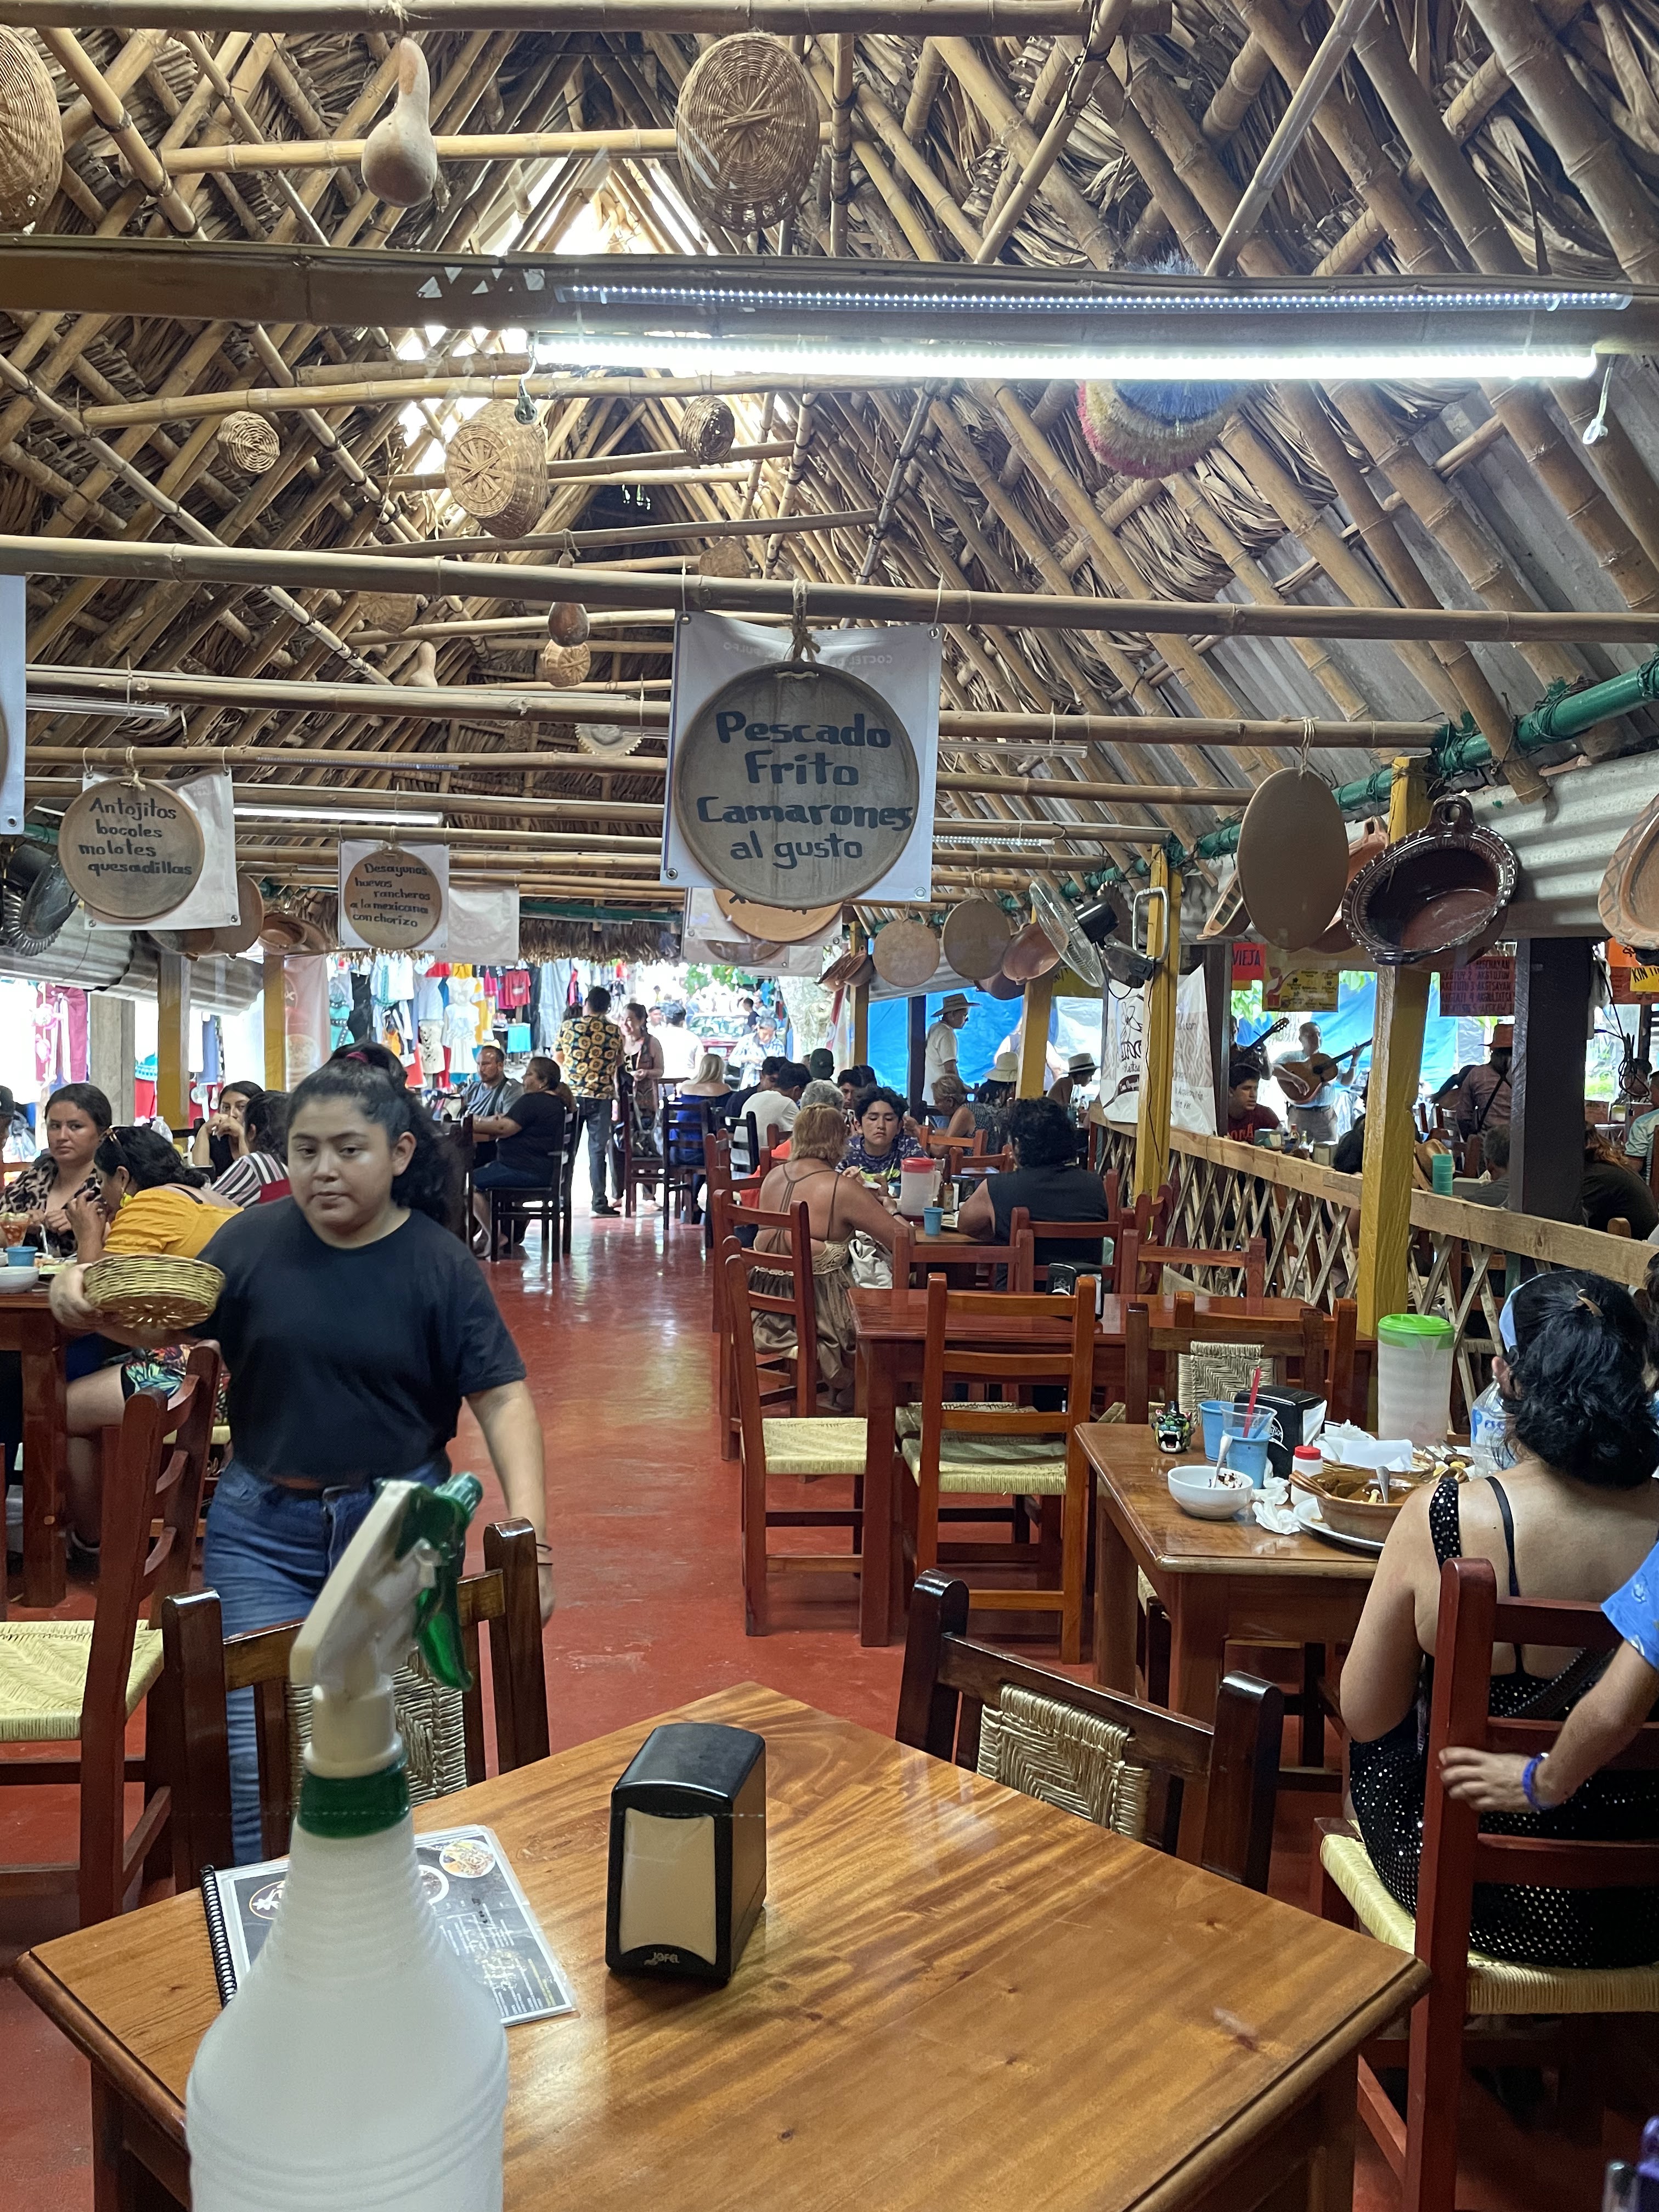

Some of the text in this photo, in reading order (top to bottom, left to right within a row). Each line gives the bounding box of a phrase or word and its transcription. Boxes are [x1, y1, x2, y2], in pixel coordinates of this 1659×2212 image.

[715, 710, 891, 749] Pescado
[744, 750, 859, 786] Frito
[89, 797, 177, 821] Antojitos
[696, 796, 913, 832] Camarones
[95, 819, 163, 838] bocoles
[78, 838, 157, 857] molotes
[730, 830, 862, 870] al gusto
[87, 860, 193, 877] quesadillas
[364, 863, 428, 877] Desayunos
[354, 877, 392, 888] huevos
[373, 888, 431, 901] rancheros
[373, 901, 428, 914] mexicana
[352, 913, 418, 927] con chorizo
[1232, 950, 1261, 966] VIEJA
